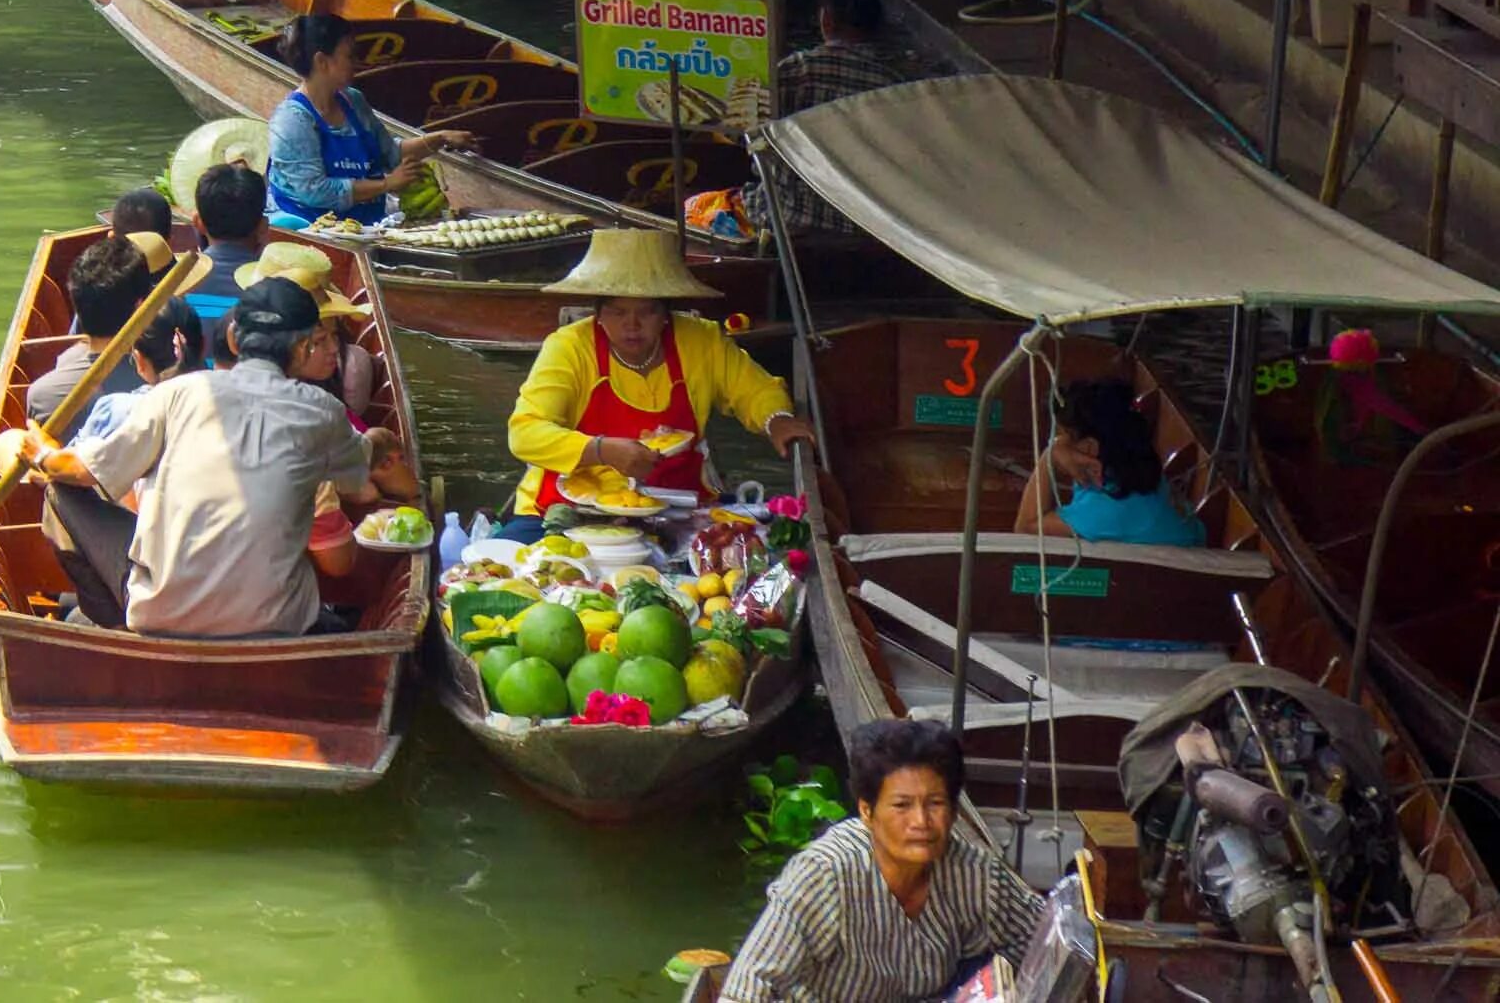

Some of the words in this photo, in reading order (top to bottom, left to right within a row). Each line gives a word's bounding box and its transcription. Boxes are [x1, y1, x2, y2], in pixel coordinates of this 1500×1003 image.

[667, 4, 768, 38] Bananas
[616, 38, 732, 78] กล้วยปิ้ง
[943, 338, 980, 396] 3
